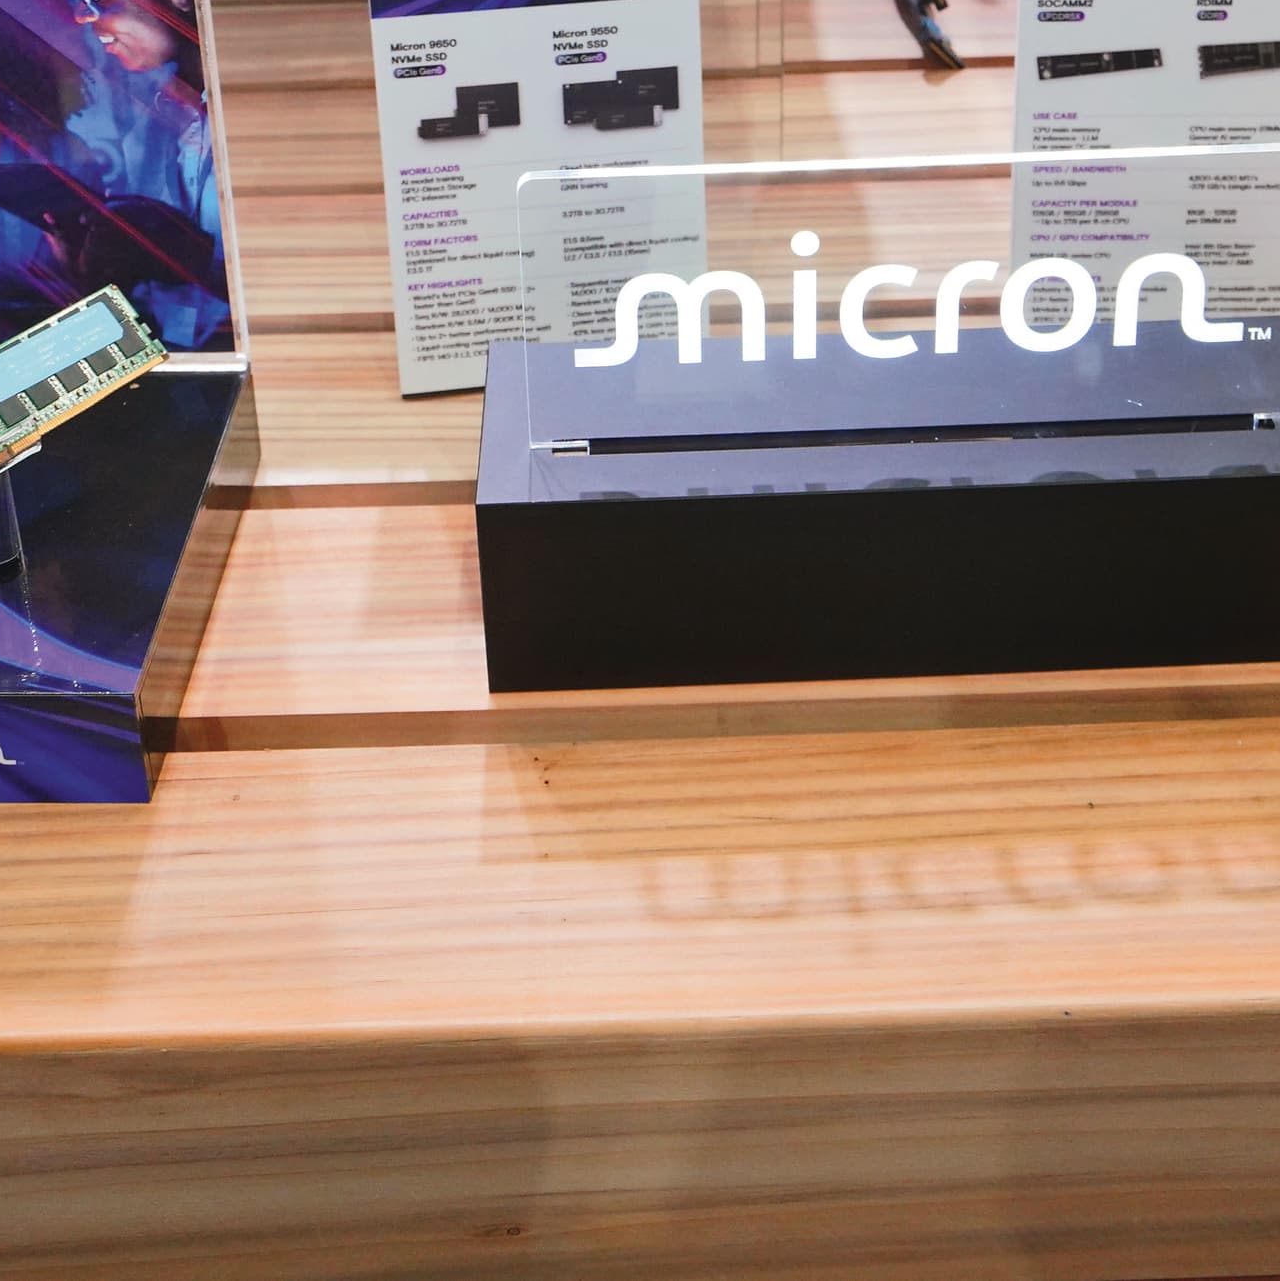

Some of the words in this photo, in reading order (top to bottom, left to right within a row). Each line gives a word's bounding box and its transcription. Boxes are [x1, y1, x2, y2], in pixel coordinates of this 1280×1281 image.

[1037, 0, 1094, 8] SOCAMM2
[552, 29, 587, 39] Micron
[590, 26, 618, 36] 9550
[390, 42, 426, 52] Micron
[429, 38, 457, 49] 9650
[553, 42, 584, 52] NVMe
[586, 39, 608, 49] SSD
[391, 54, 422, 64] NVMe
[425, 52, 447, 62] SSD
[1033, 112, 1050, 120] USE
[1053, 112, 1077, 120] CASE
[400, 165, 460, 176] WORKLOADS
[403, 209, 458, 221] CAPACITIES
[404, 239, 431, 248] FORM
[434, 235, 478, 245] FACTORS
[408, 282, 424, 291] KEY
[427, 278, 483, 290] HIGHLIGHTS
